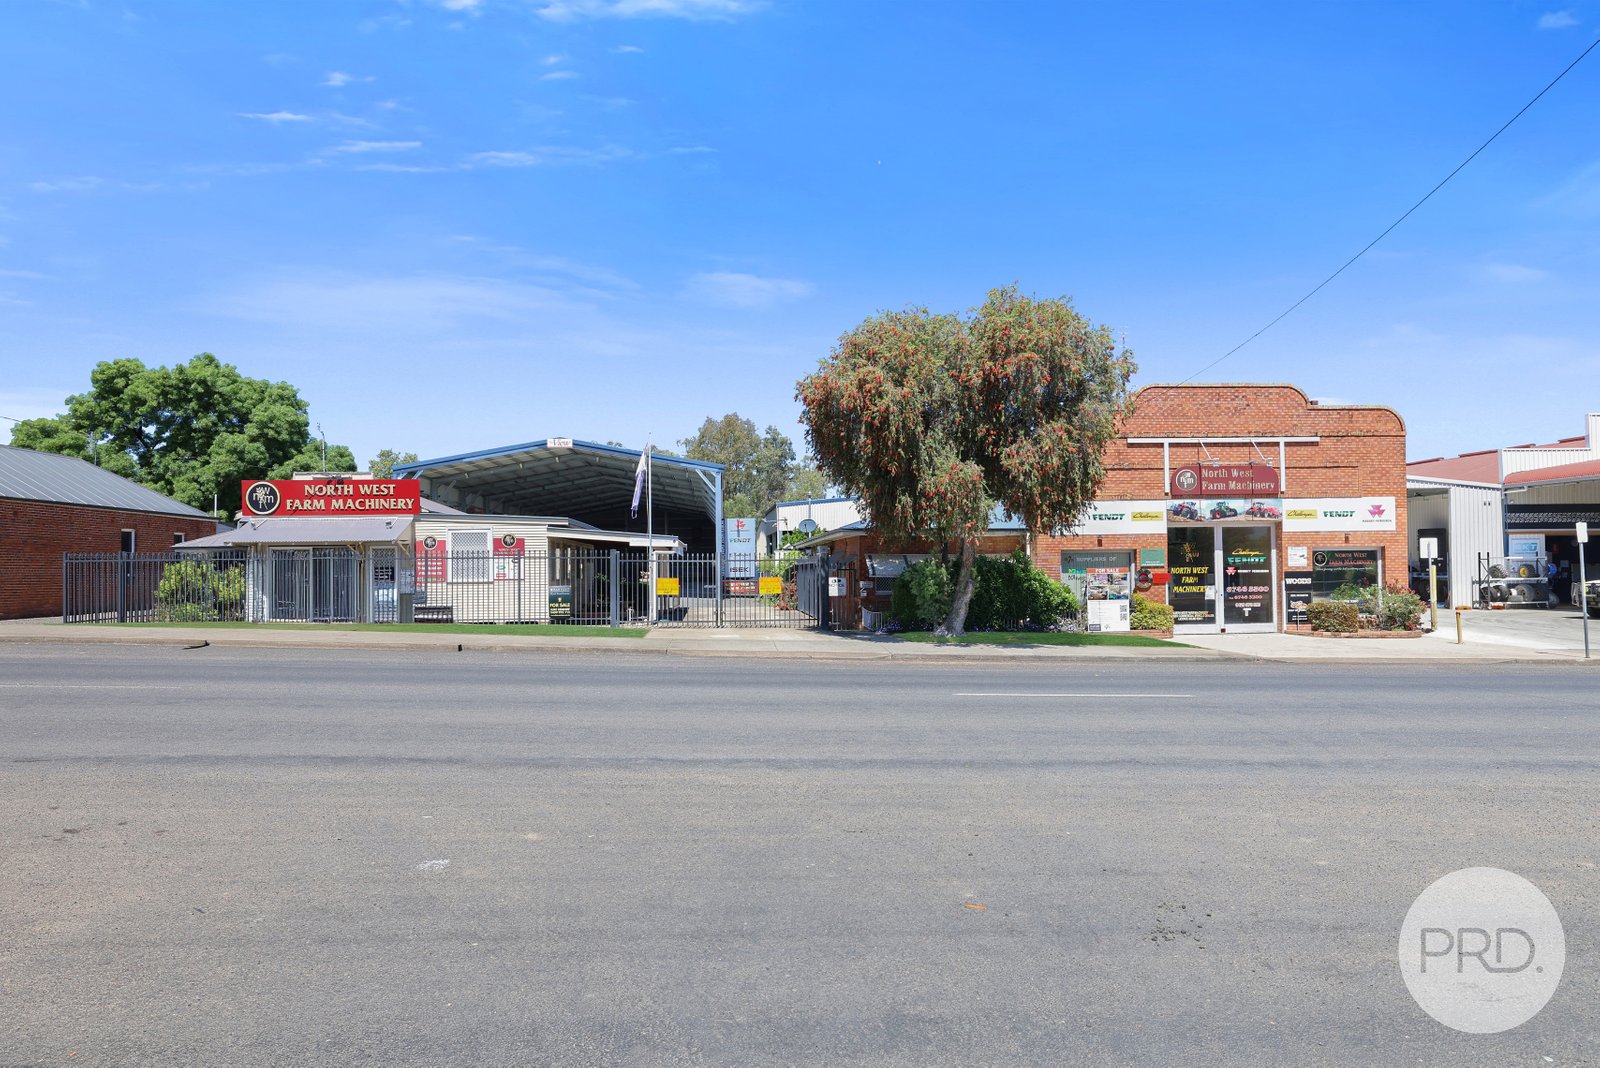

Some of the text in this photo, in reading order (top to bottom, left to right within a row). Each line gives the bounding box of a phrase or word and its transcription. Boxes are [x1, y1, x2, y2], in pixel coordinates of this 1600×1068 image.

[1201, 468, 1254, 478] North West
[304, 484, 396, 496] NORTH WEST
[1201, 481, 1276, 492] Farm Machinery
[286, 498, 415, 511] FARM MACHINERY
[1322, 510, 1356, 518] FENDT
[1227, 556, 1267, 565] FENDT
[1192, 566, 1209, 574] WEST
[1285, 577, 1312, 585] WOODS
